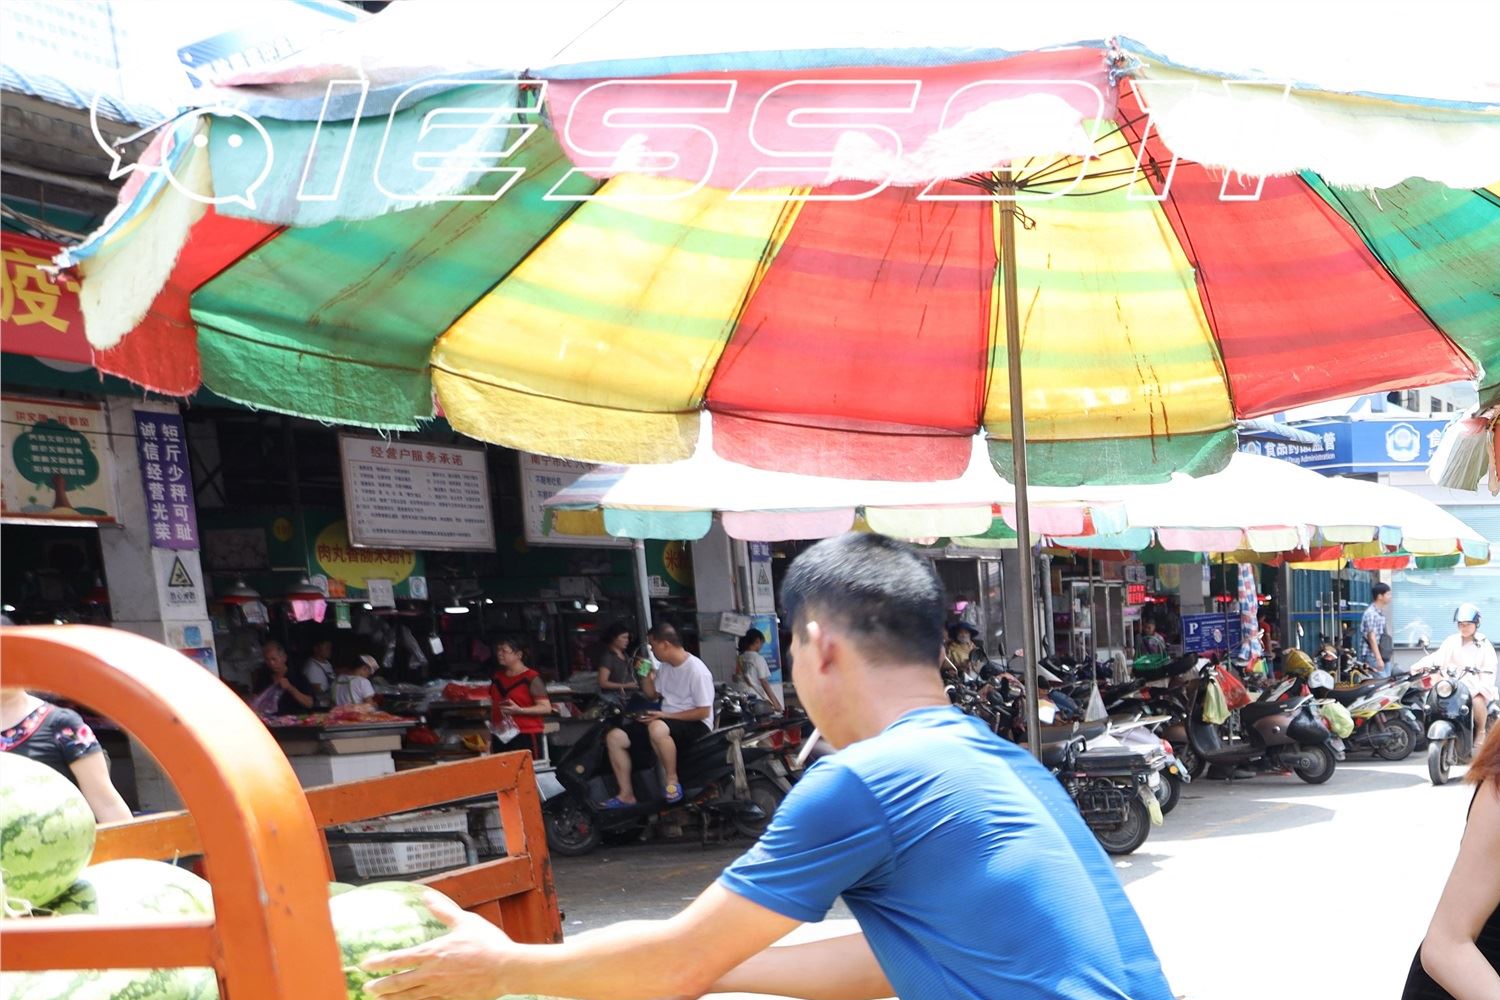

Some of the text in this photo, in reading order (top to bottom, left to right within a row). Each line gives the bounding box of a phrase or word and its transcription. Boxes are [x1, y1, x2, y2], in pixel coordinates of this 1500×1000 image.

[140, 421, 172, 541] 诚信经营光荣
[162, 423, 194, 542] 短斤少秤可耻
[370, 445, 464, 466] 经营户服务承诺
